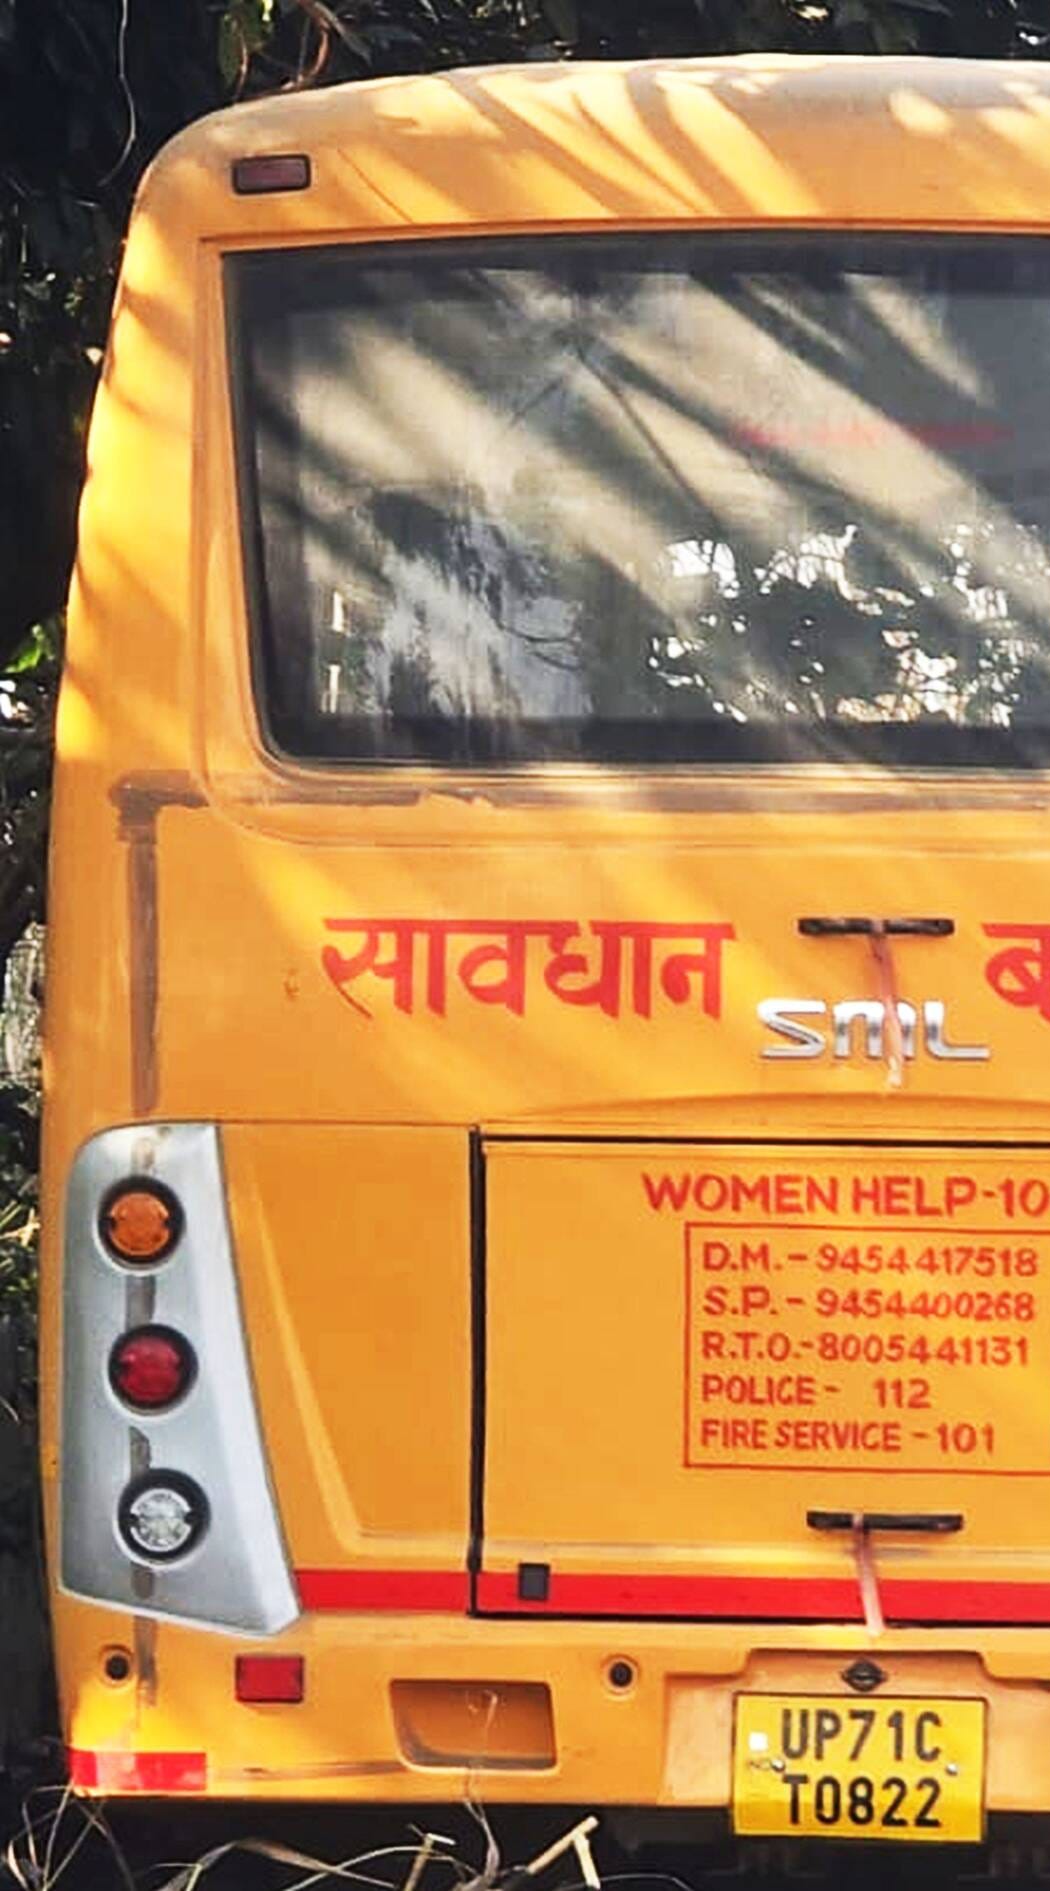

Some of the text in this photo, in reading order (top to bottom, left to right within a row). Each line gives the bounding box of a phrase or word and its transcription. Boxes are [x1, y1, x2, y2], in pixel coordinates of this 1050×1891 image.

[322, 918, 735, 1018] सावधान
[641, 1173, 839, 1214] WOMEN
[873, 1378, 932, 1410] 112
[701, 1418, 769, 1450] FIRE
[774, 1419, 902, 1453] SERVICE
[781, 1708, 943, 1762] UP71C
[781, 1774, 943, 1828] T0822
